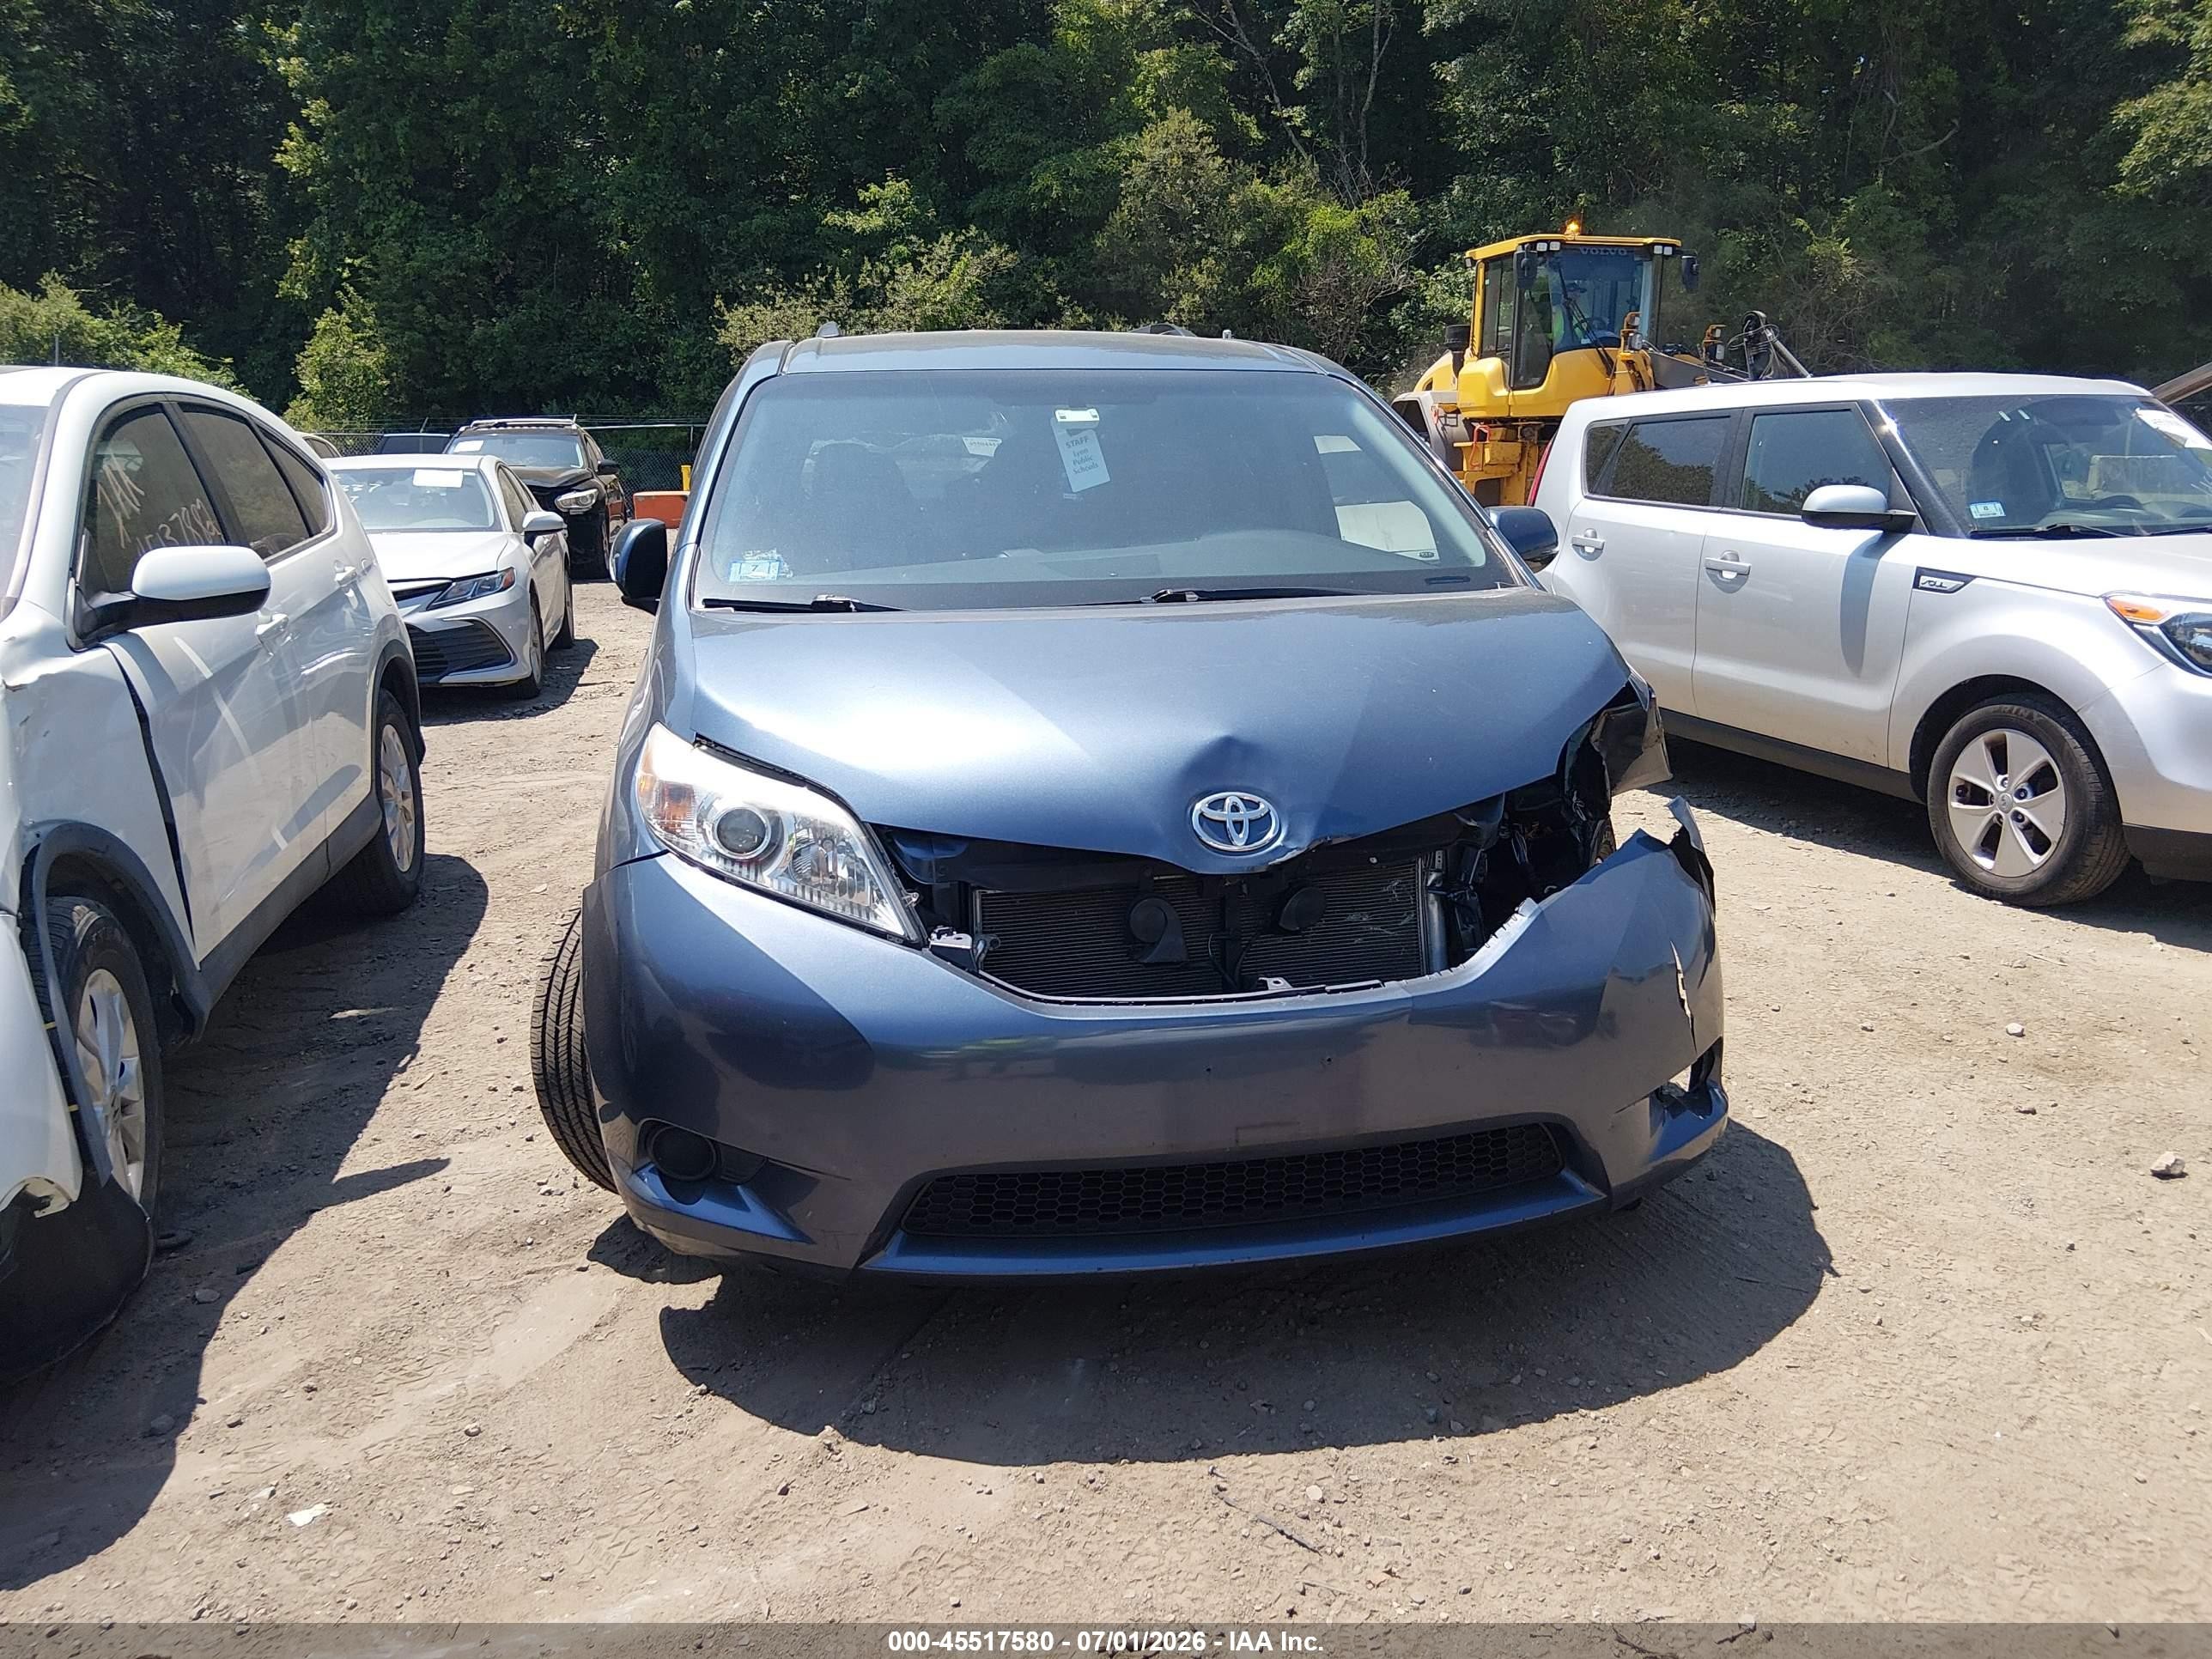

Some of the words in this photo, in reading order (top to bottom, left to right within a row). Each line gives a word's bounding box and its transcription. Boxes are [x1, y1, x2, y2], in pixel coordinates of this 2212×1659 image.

[1580, 246, 1627, 256] VOLVO
[1066, 435, 1090, 448] STAFF
[1073, 455, 1093, 466] Public
[1073, 462, 1099, 474] Schools
